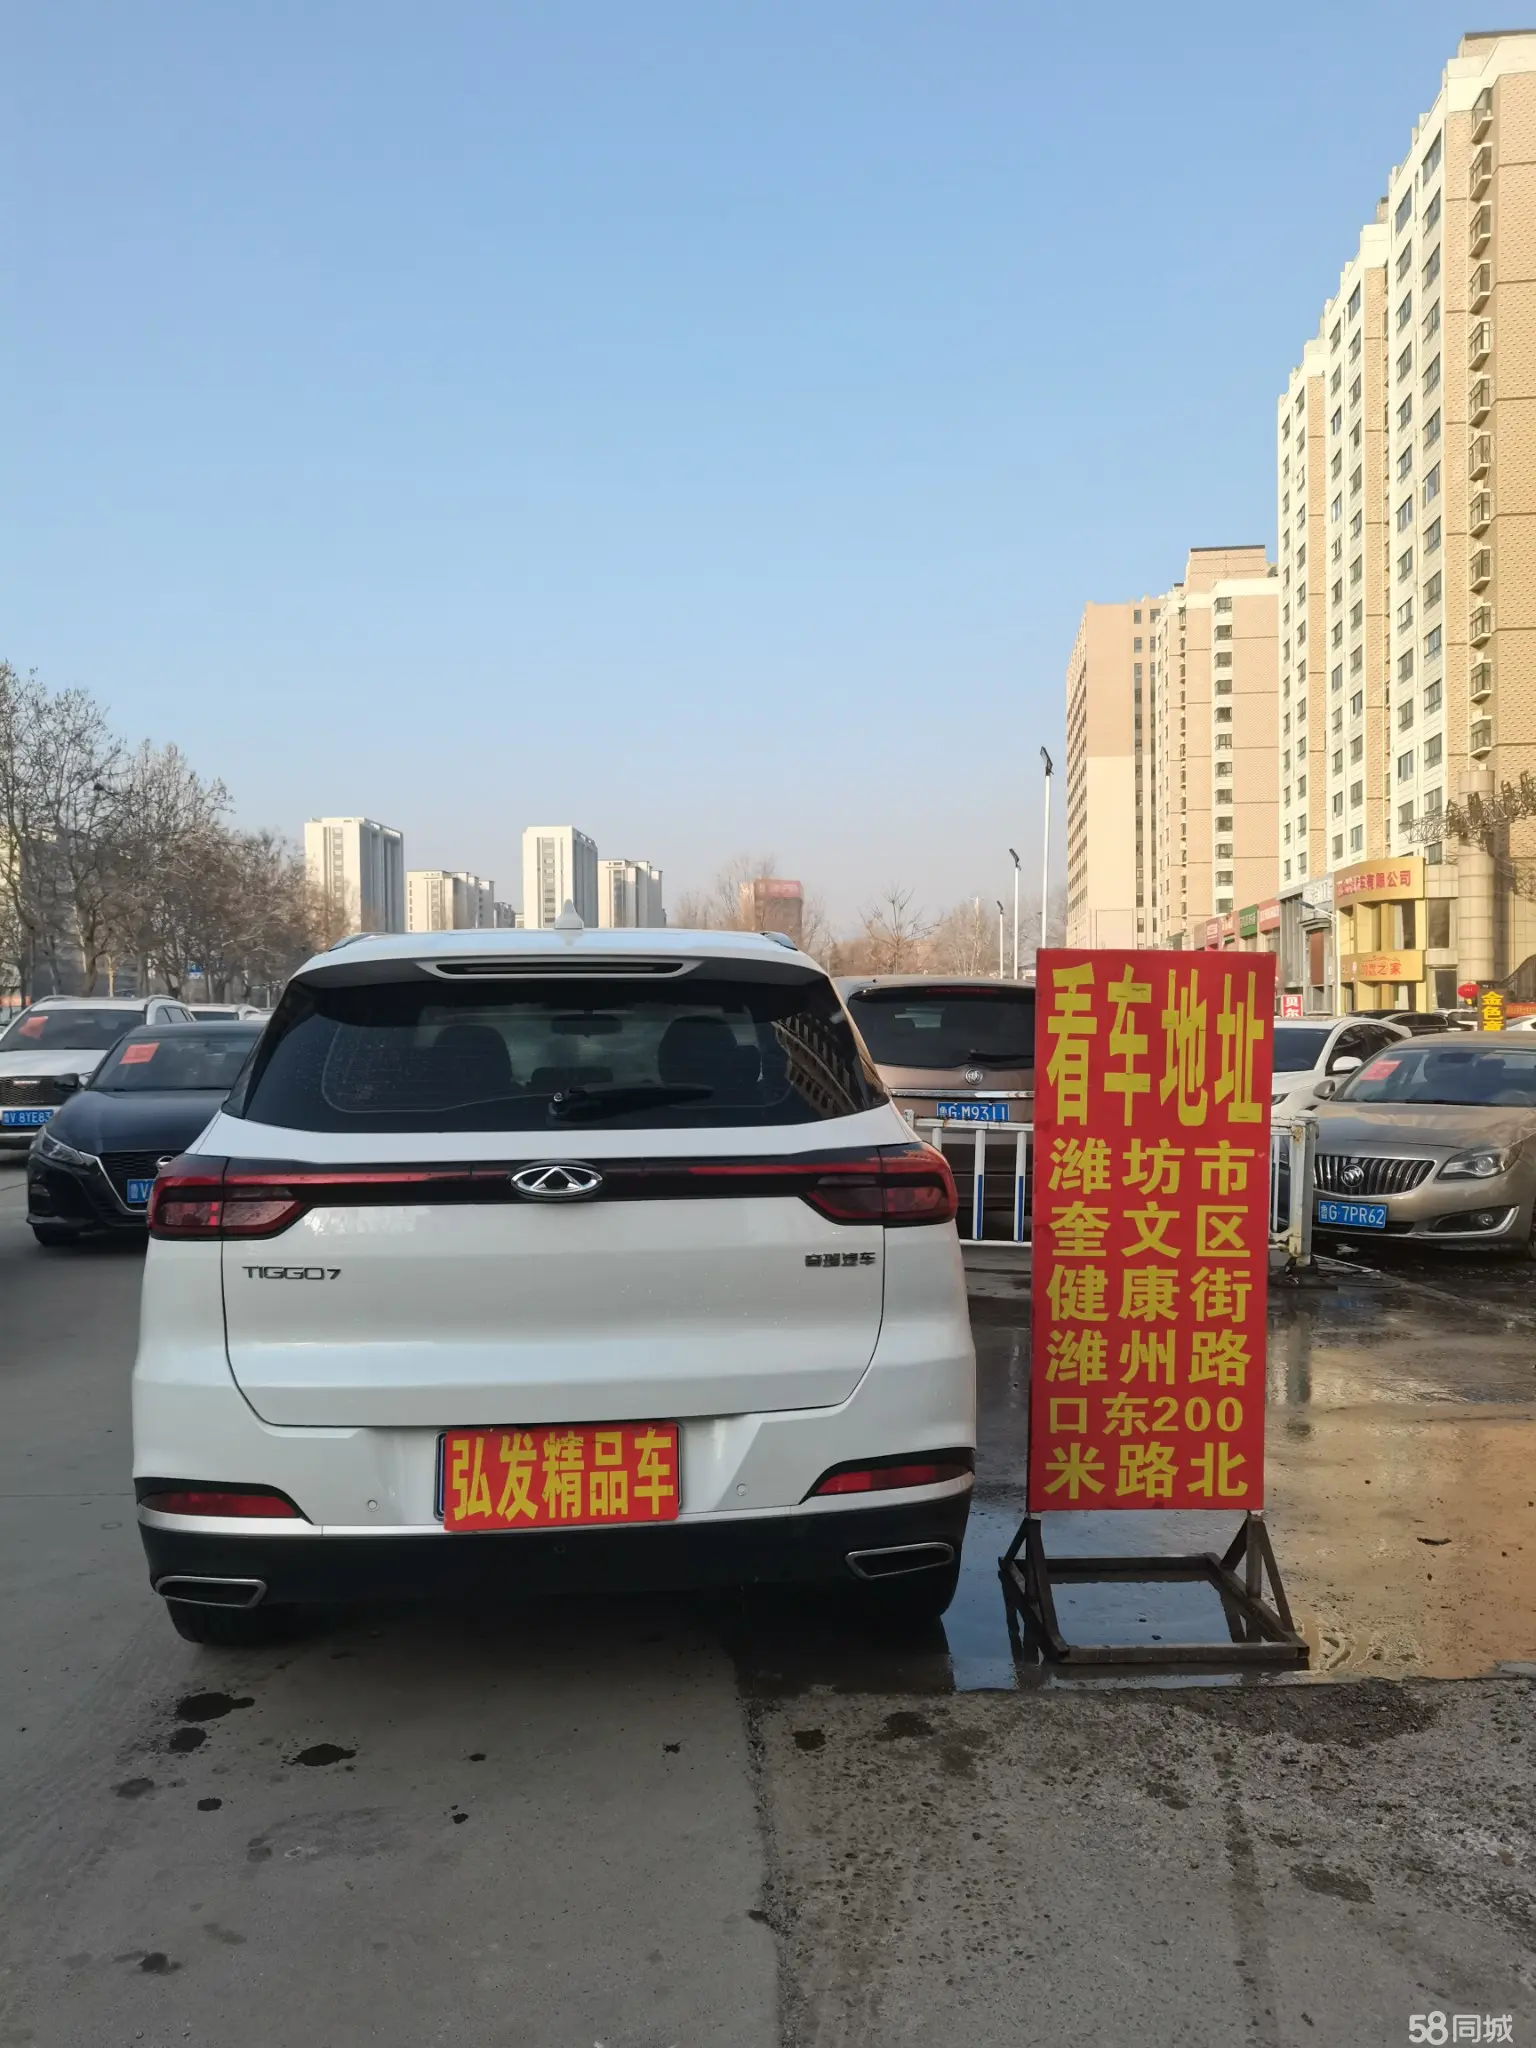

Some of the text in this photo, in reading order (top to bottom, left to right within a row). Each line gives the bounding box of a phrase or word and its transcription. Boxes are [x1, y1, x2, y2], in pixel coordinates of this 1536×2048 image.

[1046, 961, 1265, 1126] 看车地址
[1048, 1138, 1255, 1196] 潍坊市
[1049, 1201, 1252, 1259] 奎文区
[1045, 1265, 1253, 1323] 健康街
[1044, 1328, 1252, 1387] 潍州路
[1049, 1392, 1244, 1436] 口东200
[452, 1429, 674, 1522] 弘发精品车
[1044, 1441, 1249, 1501] 米路北
